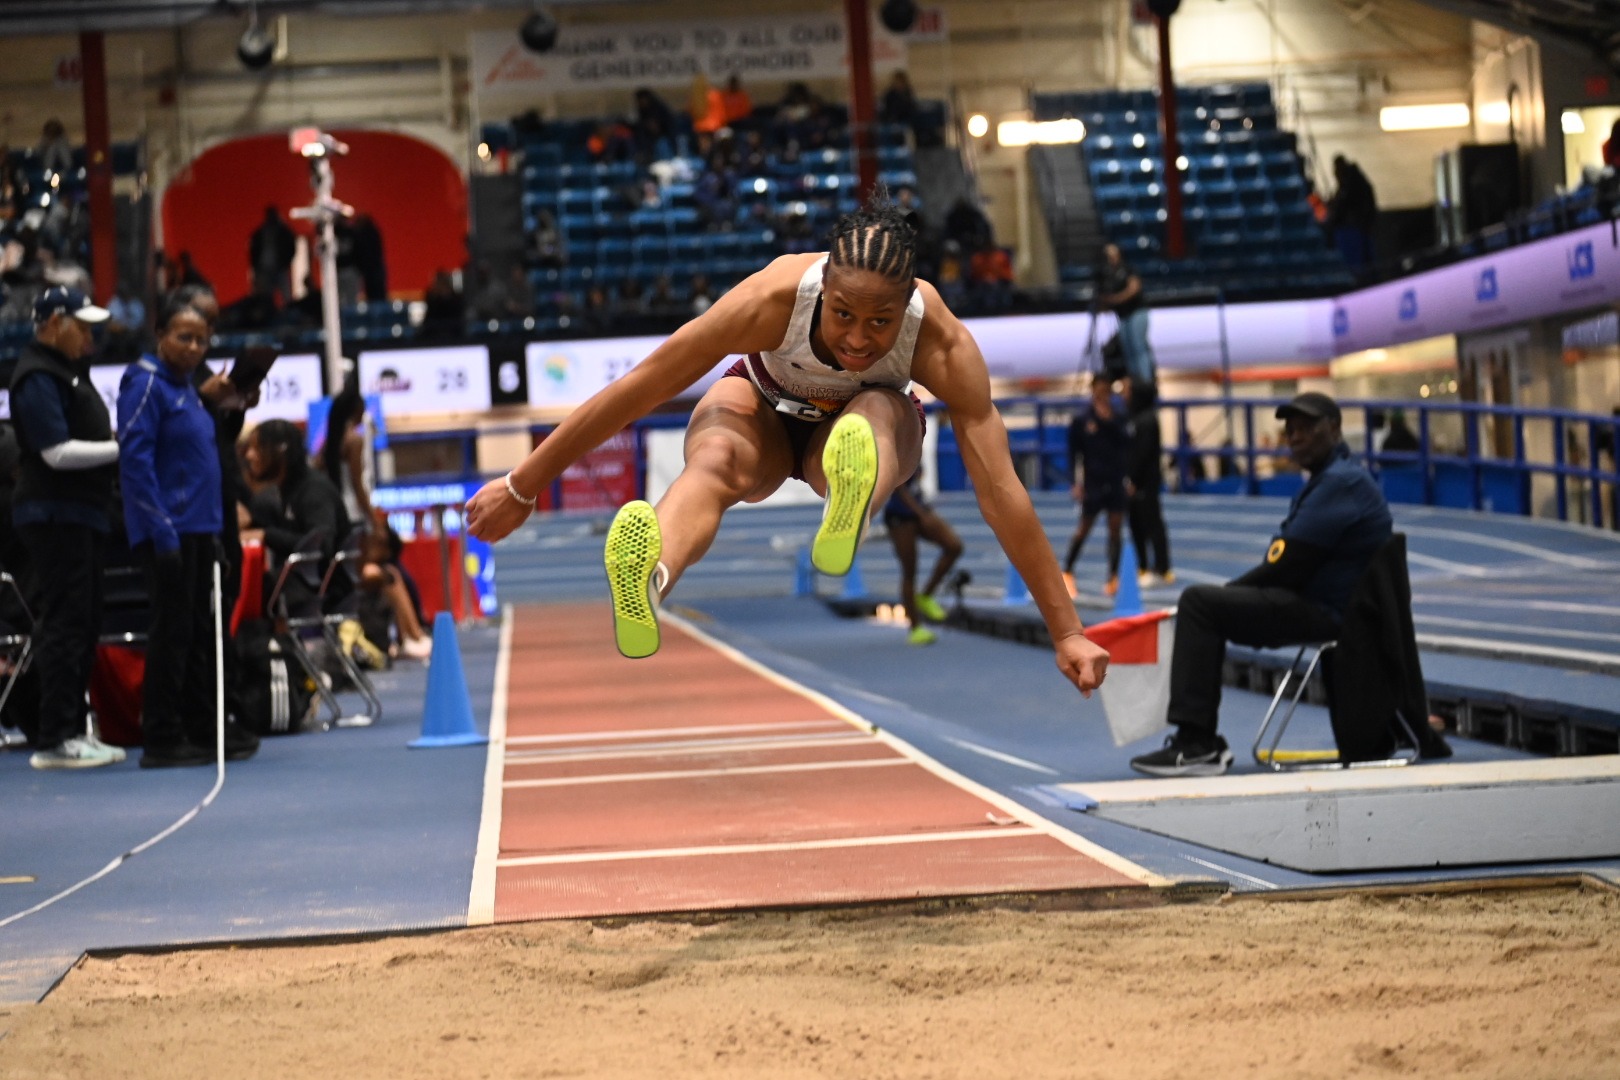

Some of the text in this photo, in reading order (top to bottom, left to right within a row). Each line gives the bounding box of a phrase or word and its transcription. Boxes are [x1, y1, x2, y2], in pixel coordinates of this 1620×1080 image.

[549, 20, 842, 56] HANK YOU TO ALL OUR
[569, 56, 701, 82] GENEROUS
[710, 47, 813, 75] DONORS
